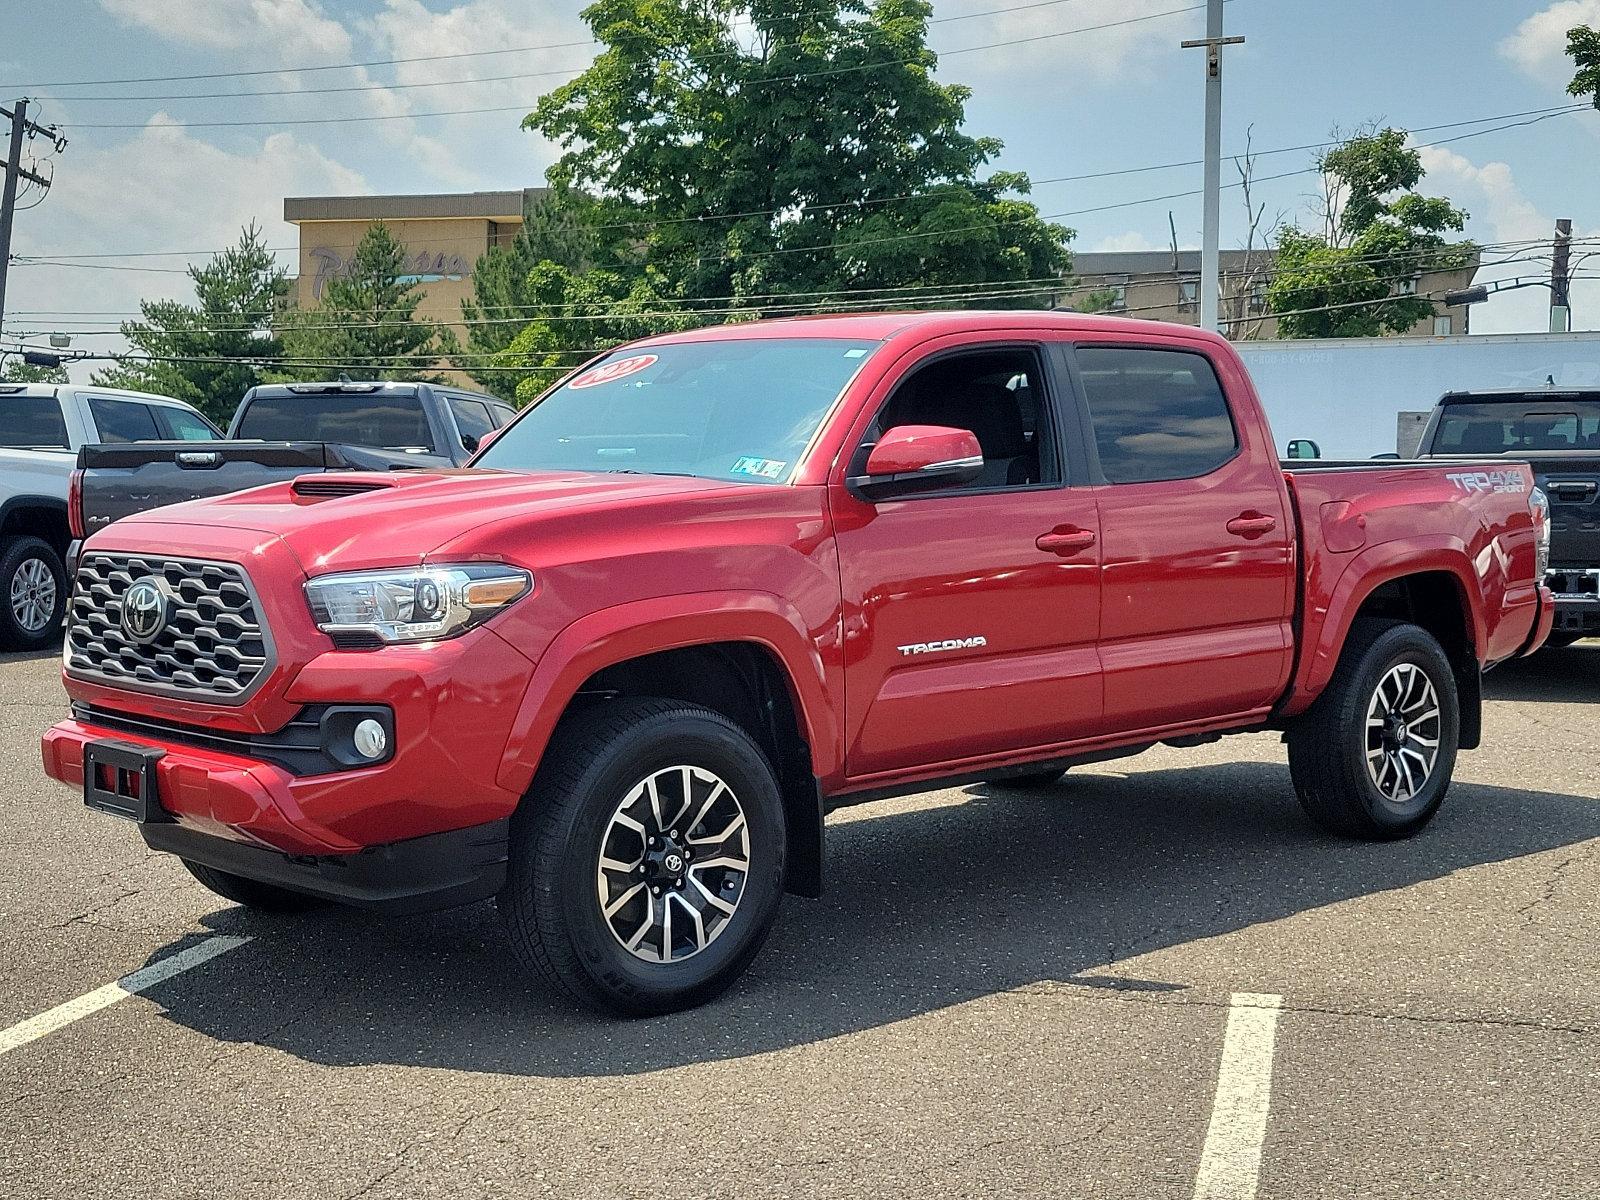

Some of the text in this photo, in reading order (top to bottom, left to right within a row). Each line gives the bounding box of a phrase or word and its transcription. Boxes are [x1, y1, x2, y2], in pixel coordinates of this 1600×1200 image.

[1446, 471, 1491, 493] TRD
[1493, 485, 1525, 493] SPORT
[897, 636, 987, 656] TACOMA
